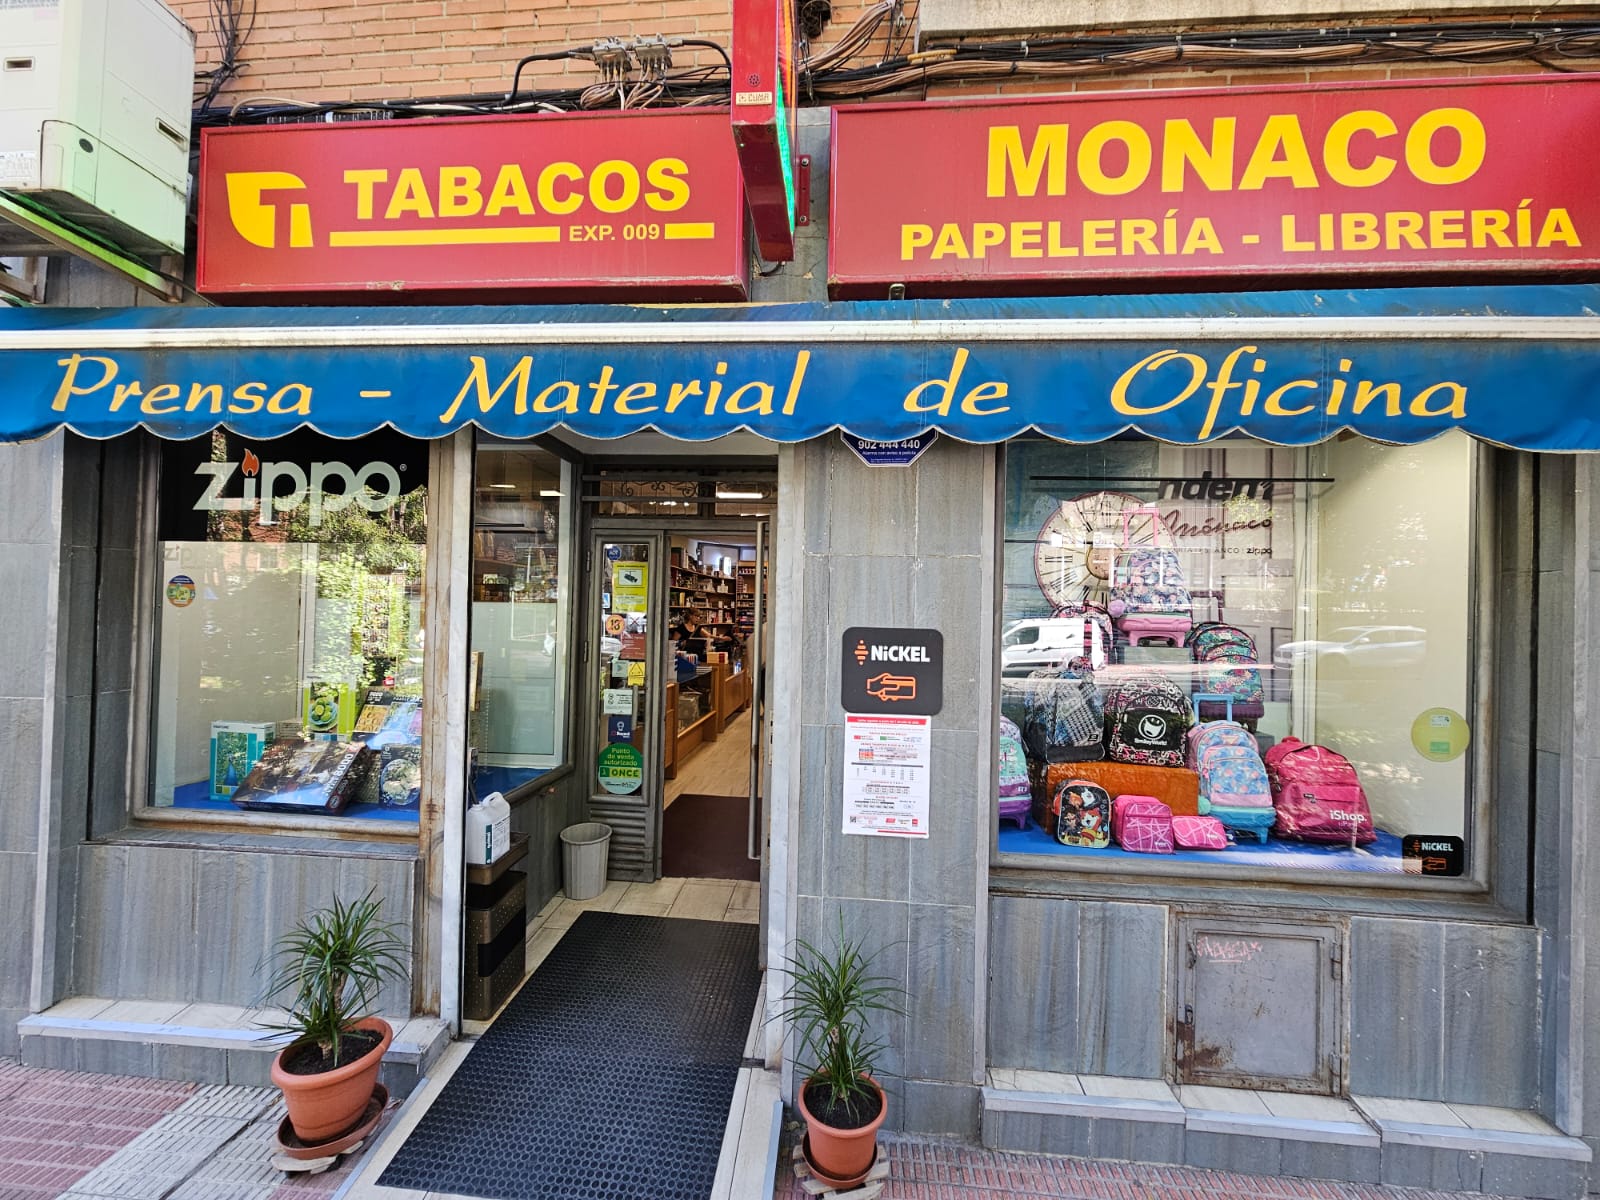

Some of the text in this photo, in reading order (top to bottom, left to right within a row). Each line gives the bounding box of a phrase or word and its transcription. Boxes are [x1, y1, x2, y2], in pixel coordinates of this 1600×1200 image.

[986, 107, 1487, 197] MONACO
[344, 157, 691, 220] TABACOS
[568, 223, 661, 243] EXP. 009
[900, 209, 1223, 260] PAPELERÍA
[1281, 199, 1582, 252] LIBRERÍA
[51, 353, 313, 416] Prensa
[439, 350, 811, 423] Material
[904, 348, 1010, 418] de
[1110, 345, 1468, 440] Oficina
[858, 440, 920, 449] 902 444 440
[871, 644, 931, 663] NiCKEL
[612, 769, 639, 777] ONCE
